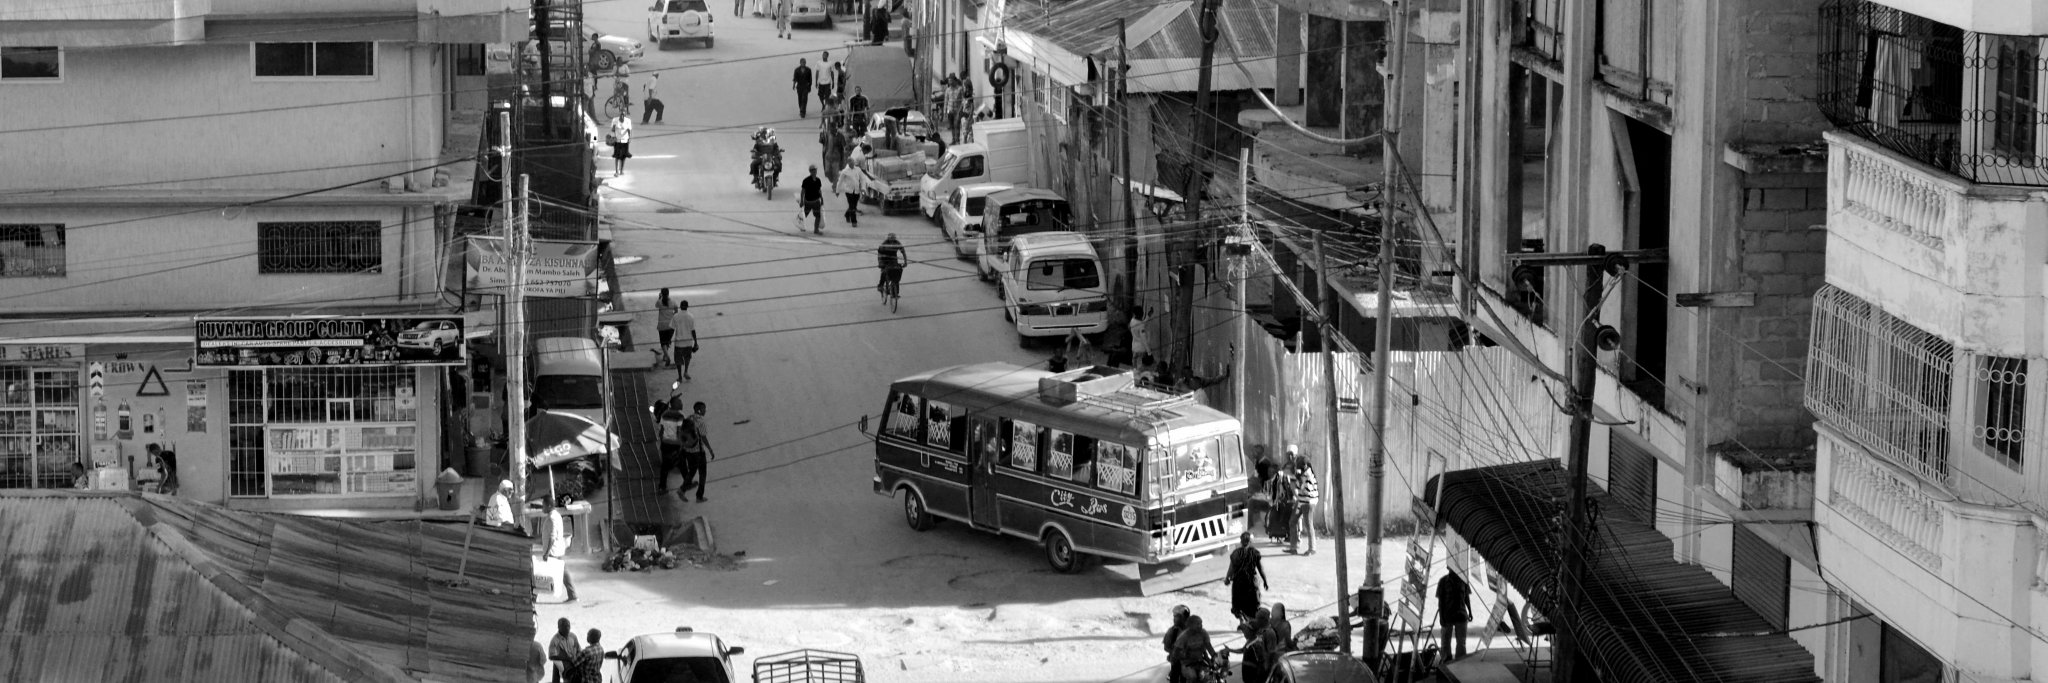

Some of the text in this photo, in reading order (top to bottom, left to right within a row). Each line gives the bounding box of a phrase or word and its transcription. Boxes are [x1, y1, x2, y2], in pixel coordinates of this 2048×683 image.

[199, 320, 365, 338] LUVANDA GROUP CO.LTD
[20, 346, 72, 360] SPARES
[104, 362, 145, 374] CROWN
[1050, 488, 1107, 515] City Bus
